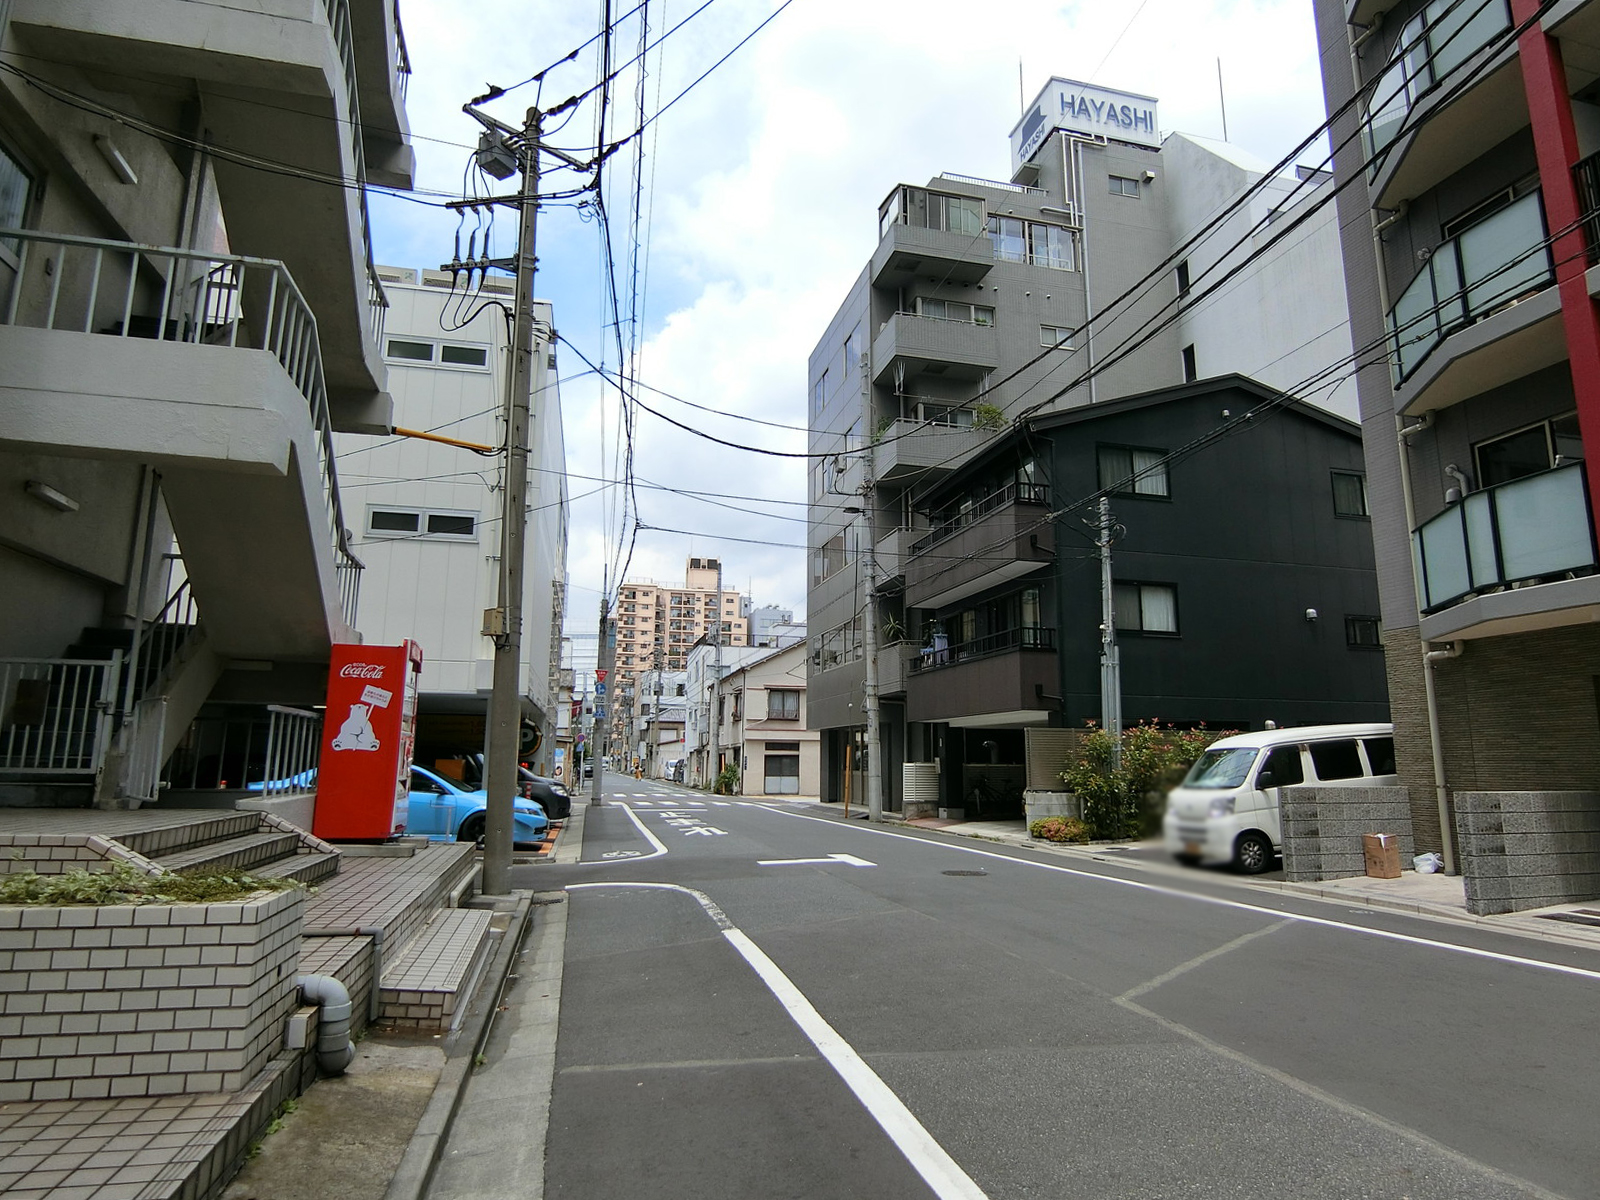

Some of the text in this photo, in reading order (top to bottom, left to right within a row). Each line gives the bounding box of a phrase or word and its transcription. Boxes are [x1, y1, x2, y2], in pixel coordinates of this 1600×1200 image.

[1060, 92, 1154, 133] HAYASHI
[1020, 122, 1046, 162] HAYASHI
[340, 663, 386, 679] Coca-Cola
[659, 811, 729, 836] 止まれ
